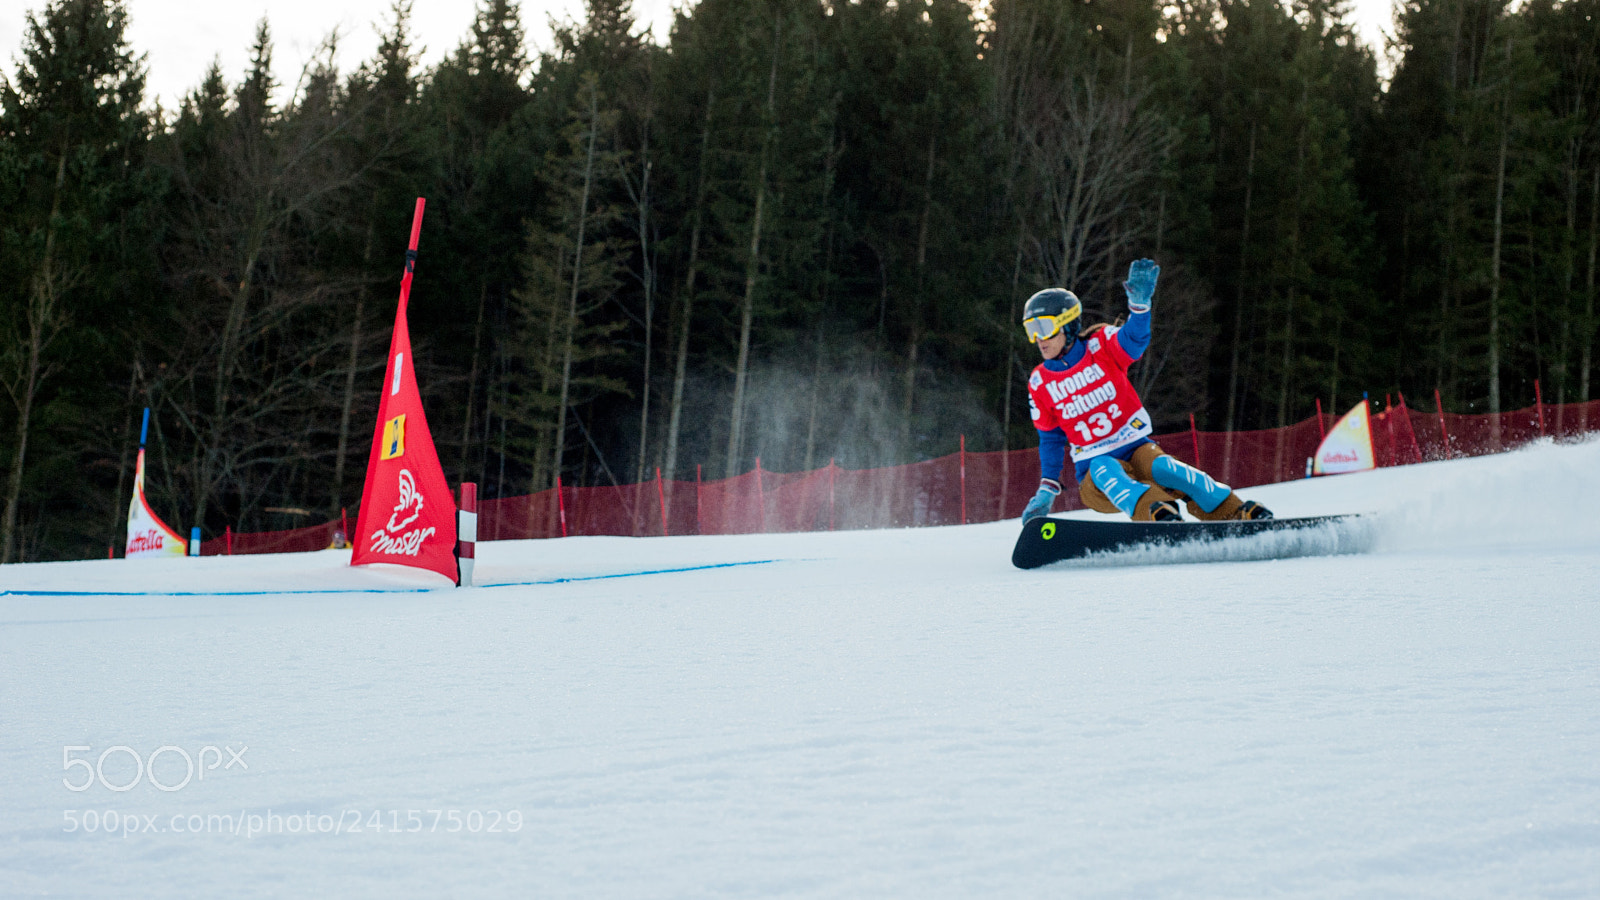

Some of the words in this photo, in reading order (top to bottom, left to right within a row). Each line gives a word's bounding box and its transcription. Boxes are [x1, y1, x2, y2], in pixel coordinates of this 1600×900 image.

[1045, 362, 1106, 404] Kronen
[1055, 380, 1118, 420] Zeitung
[370, 526, 436, 557] moser
